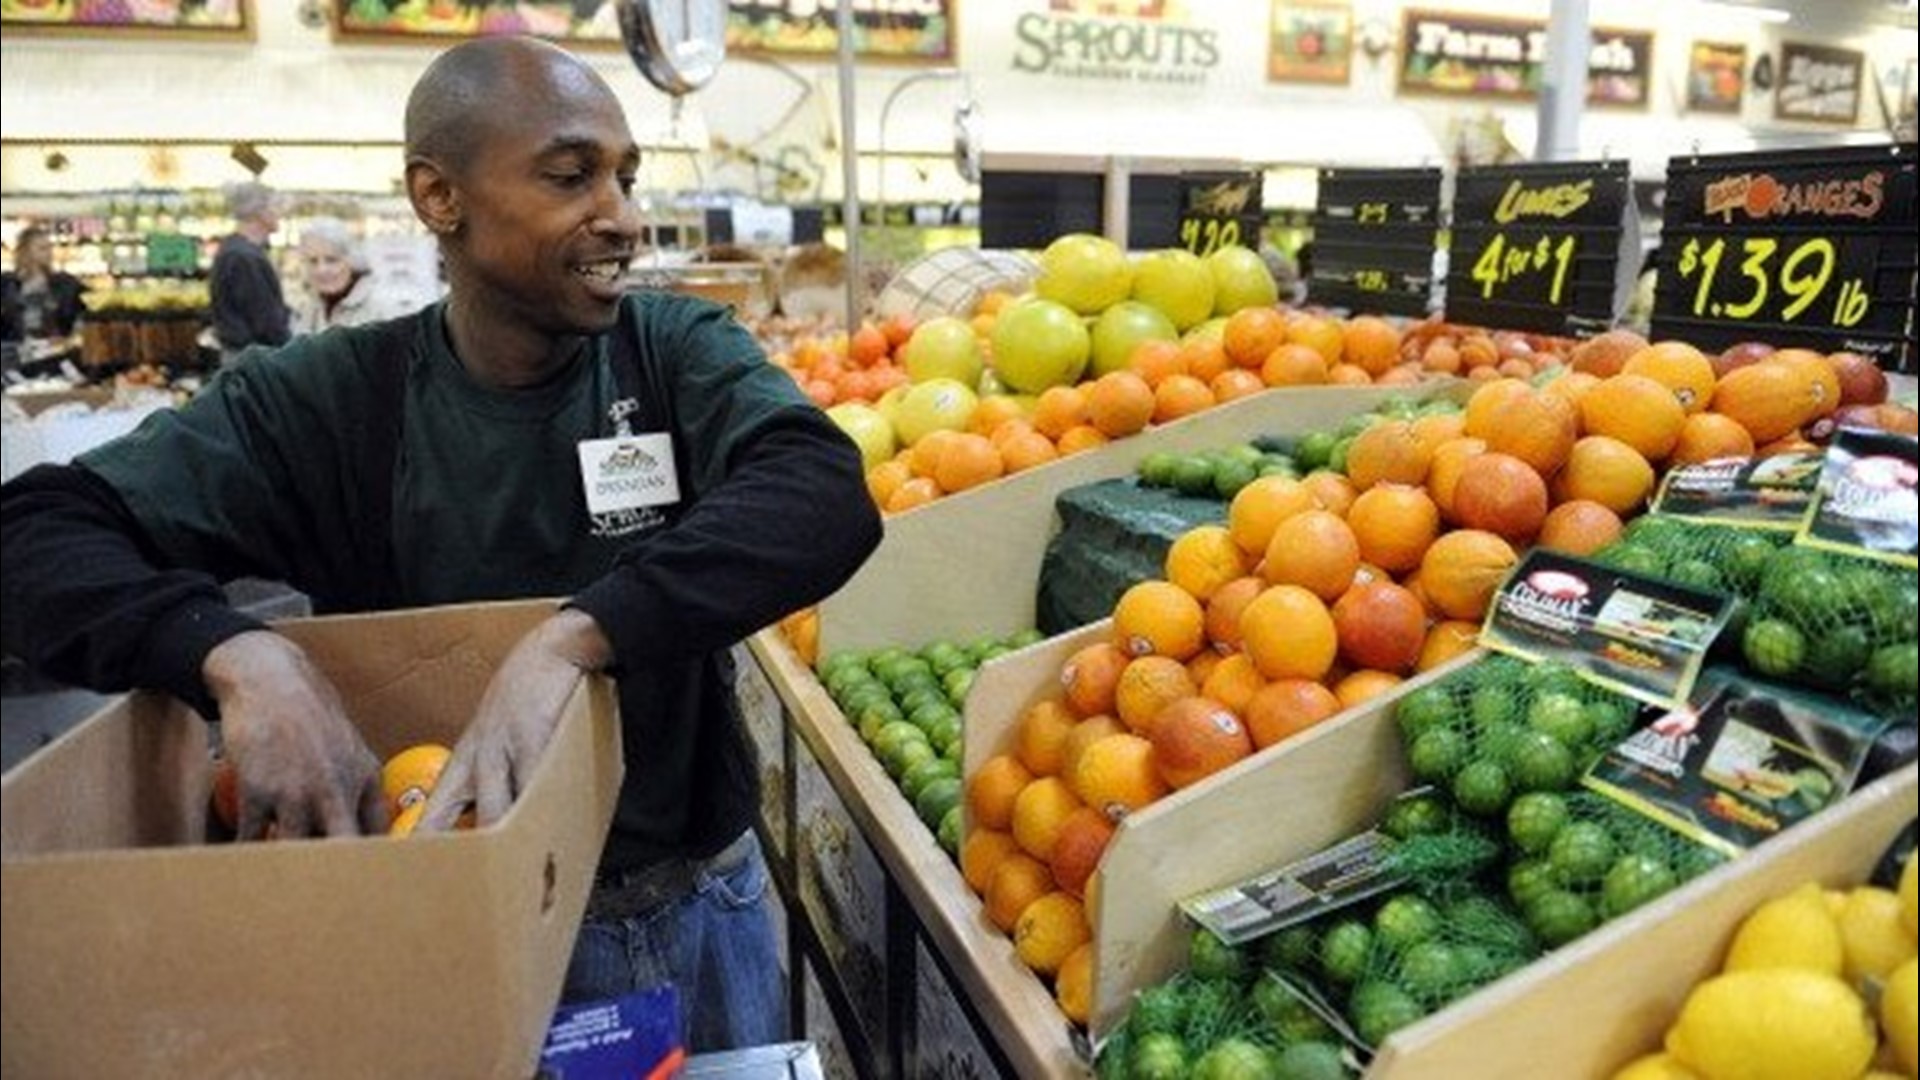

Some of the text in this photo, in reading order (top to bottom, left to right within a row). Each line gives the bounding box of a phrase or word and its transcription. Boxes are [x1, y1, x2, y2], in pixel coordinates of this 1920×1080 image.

[1010, 12, 1220, 73] SPROUTS
[1415, 22, 1522, 61] Farm
[1744, 170, 1885, 220] ORANGES
[1677, 237, 1869, 327] $1.39 lb
